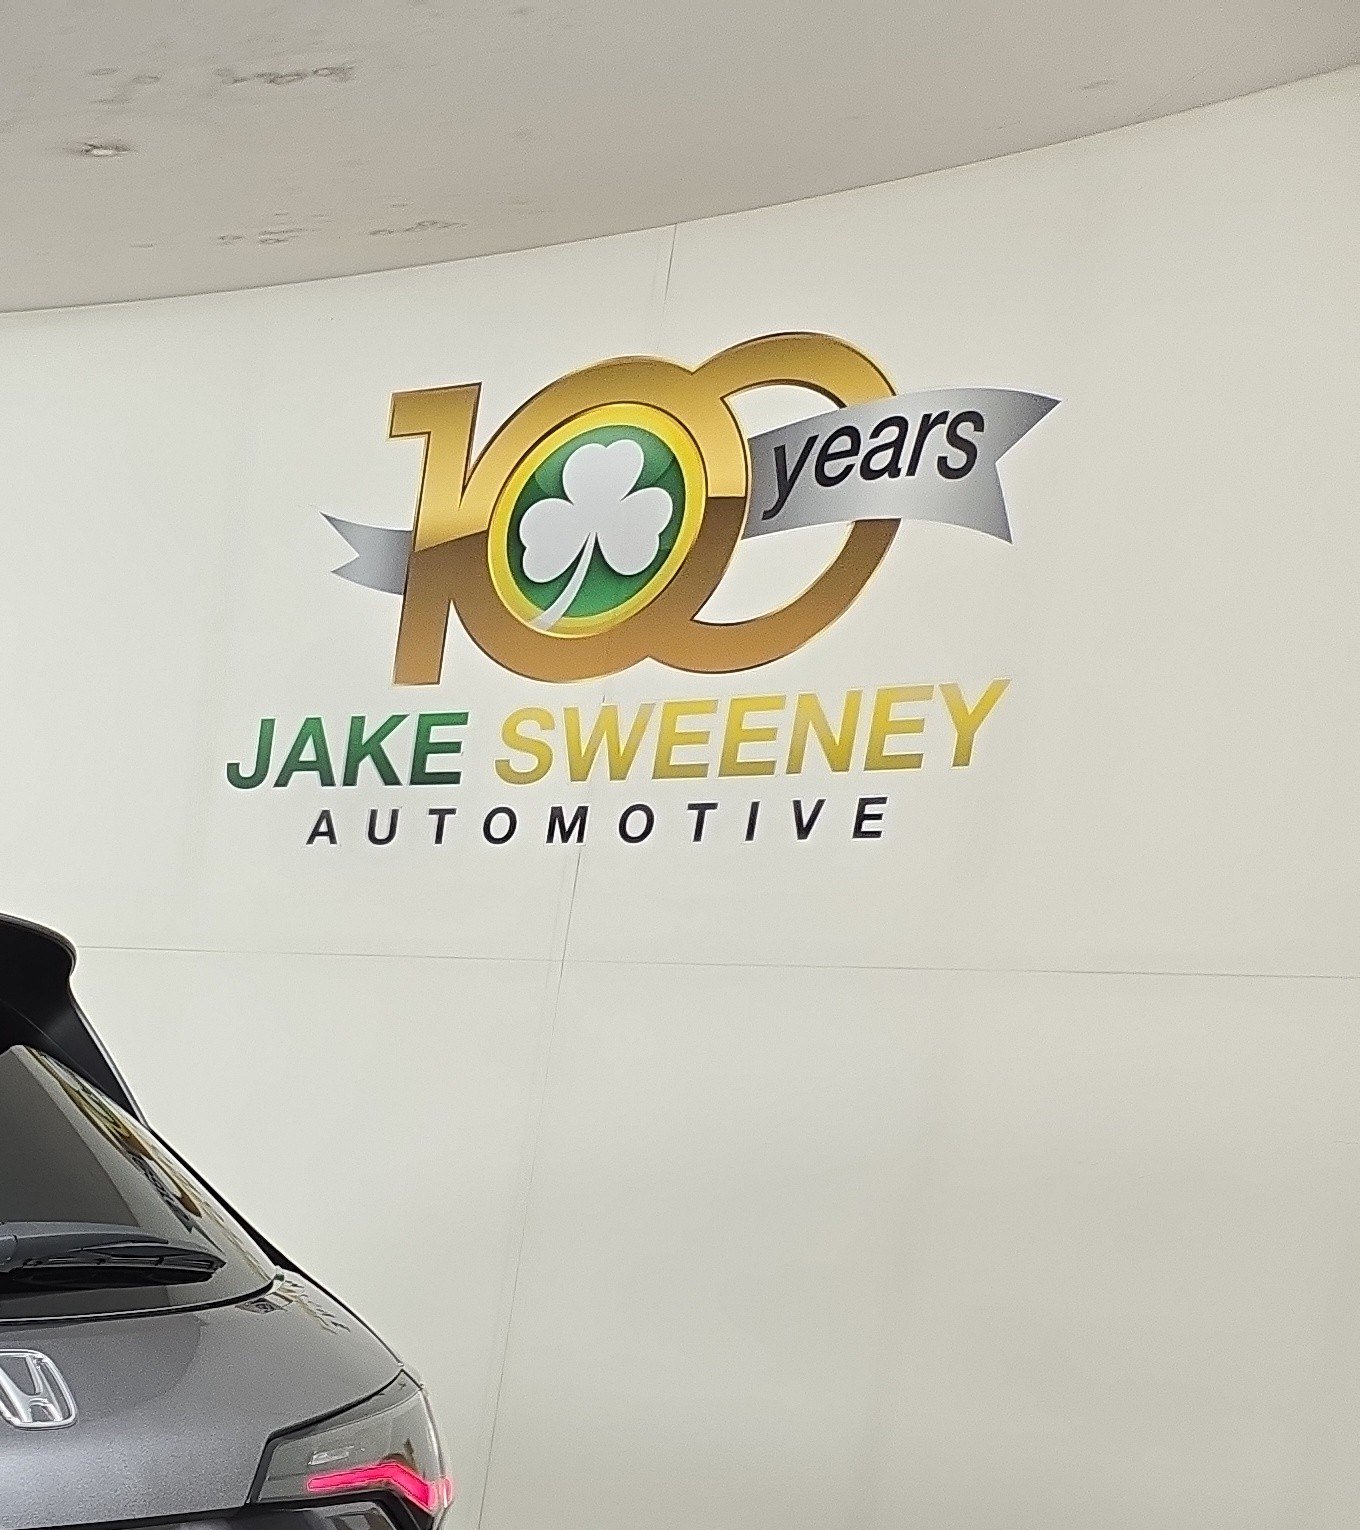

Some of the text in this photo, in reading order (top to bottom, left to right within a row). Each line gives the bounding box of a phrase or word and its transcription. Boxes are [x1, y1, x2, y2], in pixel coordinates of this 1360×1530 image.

[761, 410, 986, 523] years
[226, 679, 1011, 789] JAKE SWEENEY
[305, 796, 888, 848] AUTOMOTIVE
